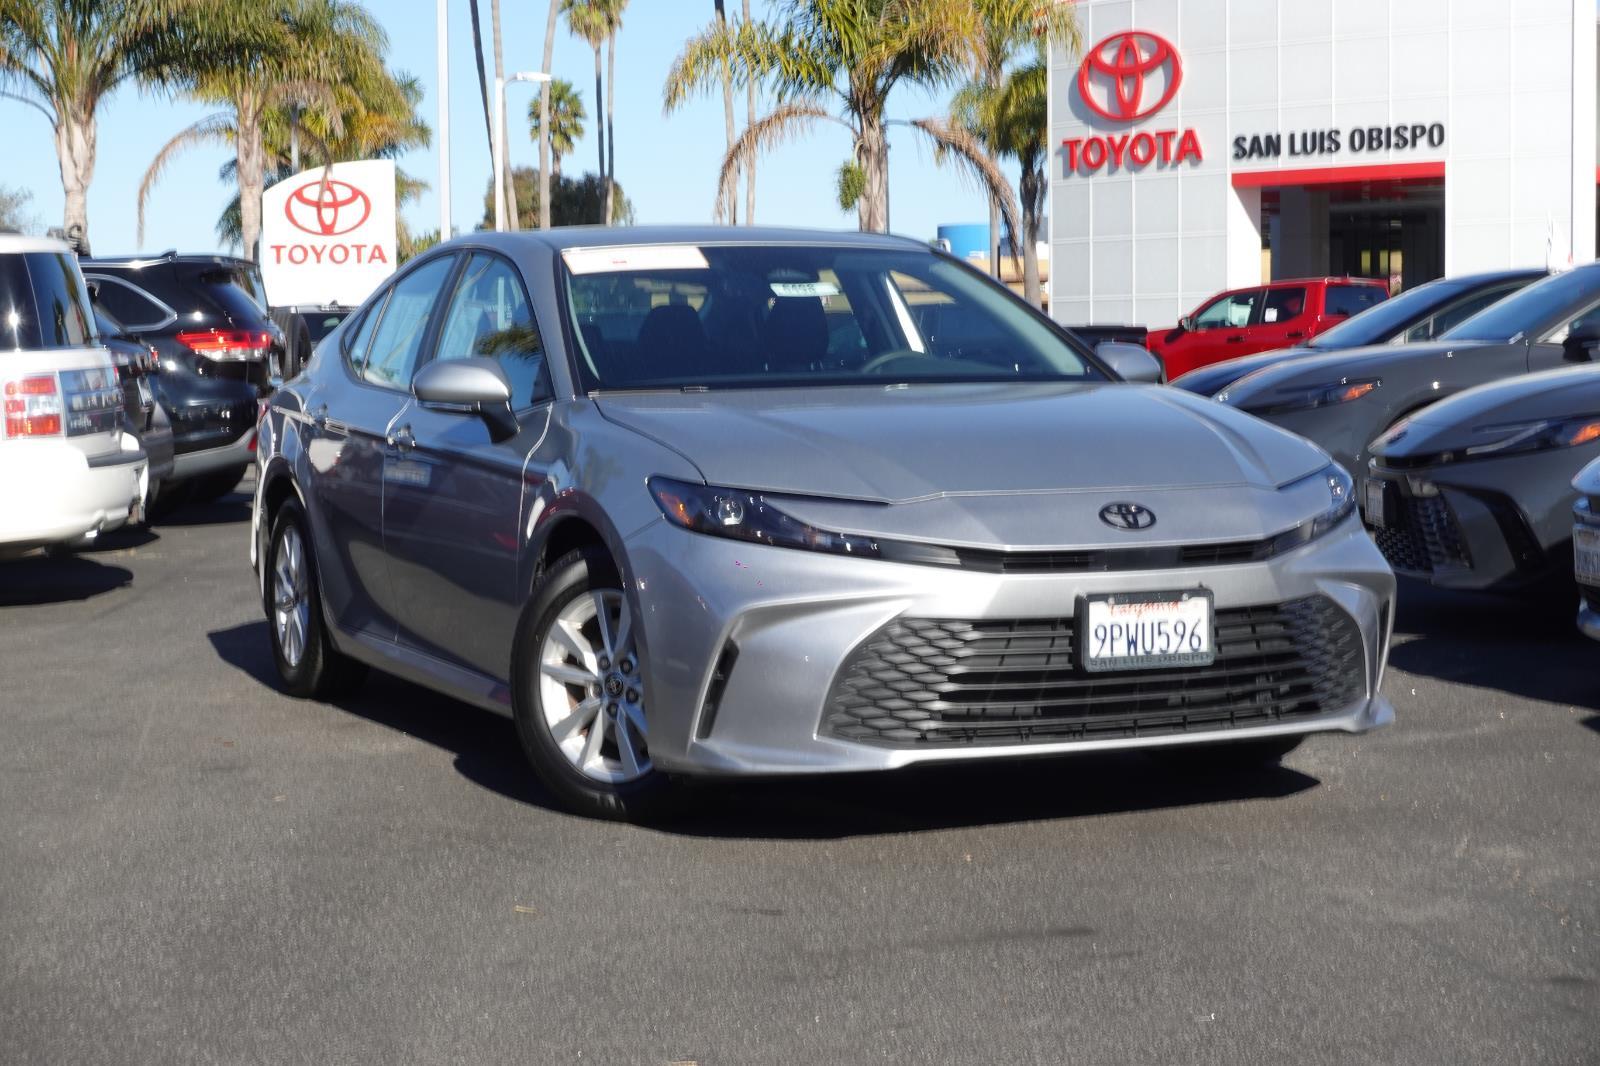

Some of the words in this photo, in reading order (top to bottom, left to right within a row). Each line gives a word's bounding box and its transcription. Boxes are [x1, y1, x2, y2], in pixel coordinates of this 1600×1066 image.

[1062, 127, 1204, 171] TOYOTA
[1233, 133, 1281, 160] SAN
[1287, 129, 1341, 156] LUIS
[1349, 123, 1445, 153] OBISPO
[270, 243, 388, 265] TOYOTA
[1094, 618, 1202, 658] 9PWU596
